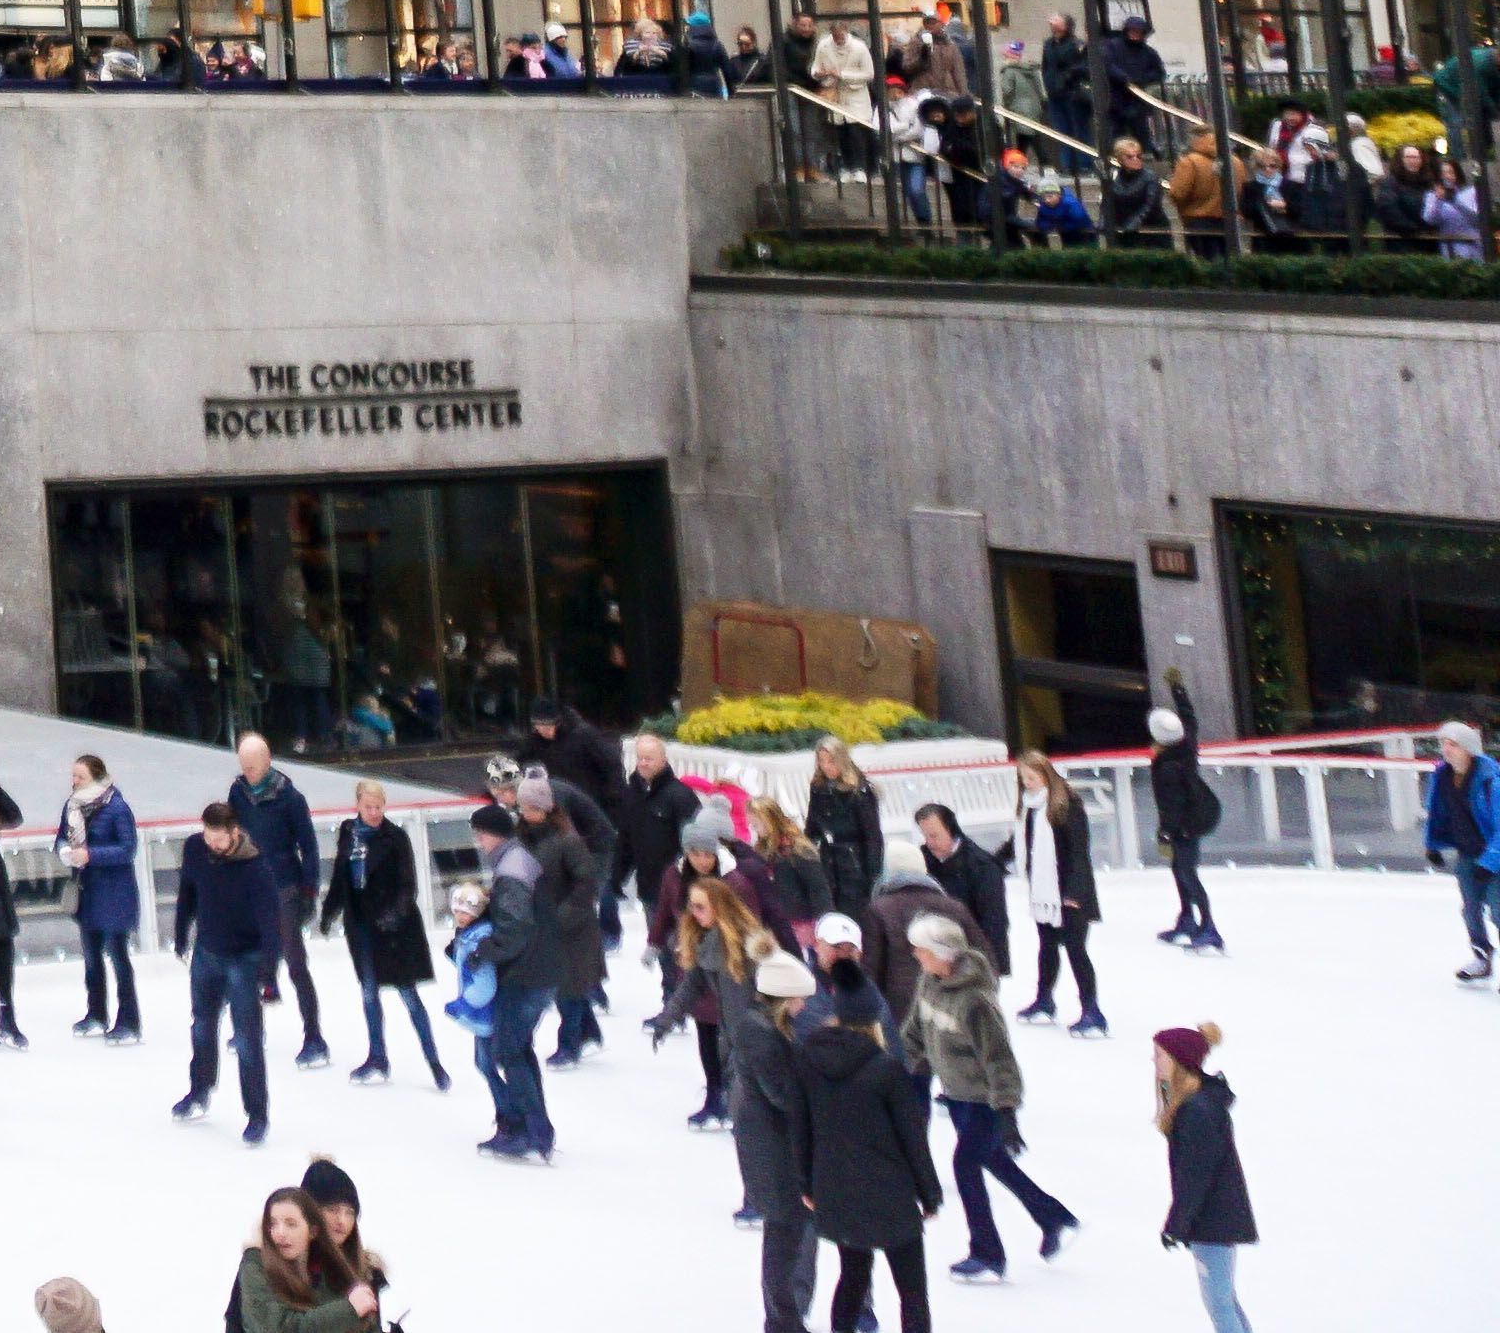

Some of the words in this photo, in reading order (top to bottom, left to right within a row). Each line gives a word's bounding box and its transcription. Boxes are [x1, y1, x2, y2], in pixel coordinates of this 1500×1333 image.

[248, 365, 300, 392] THE
[310, 359, 476, 389] CONCOURSE
[204, 405, 403, 439] ROCKEFELLER
[415, 401, 523, 432] CENTER
